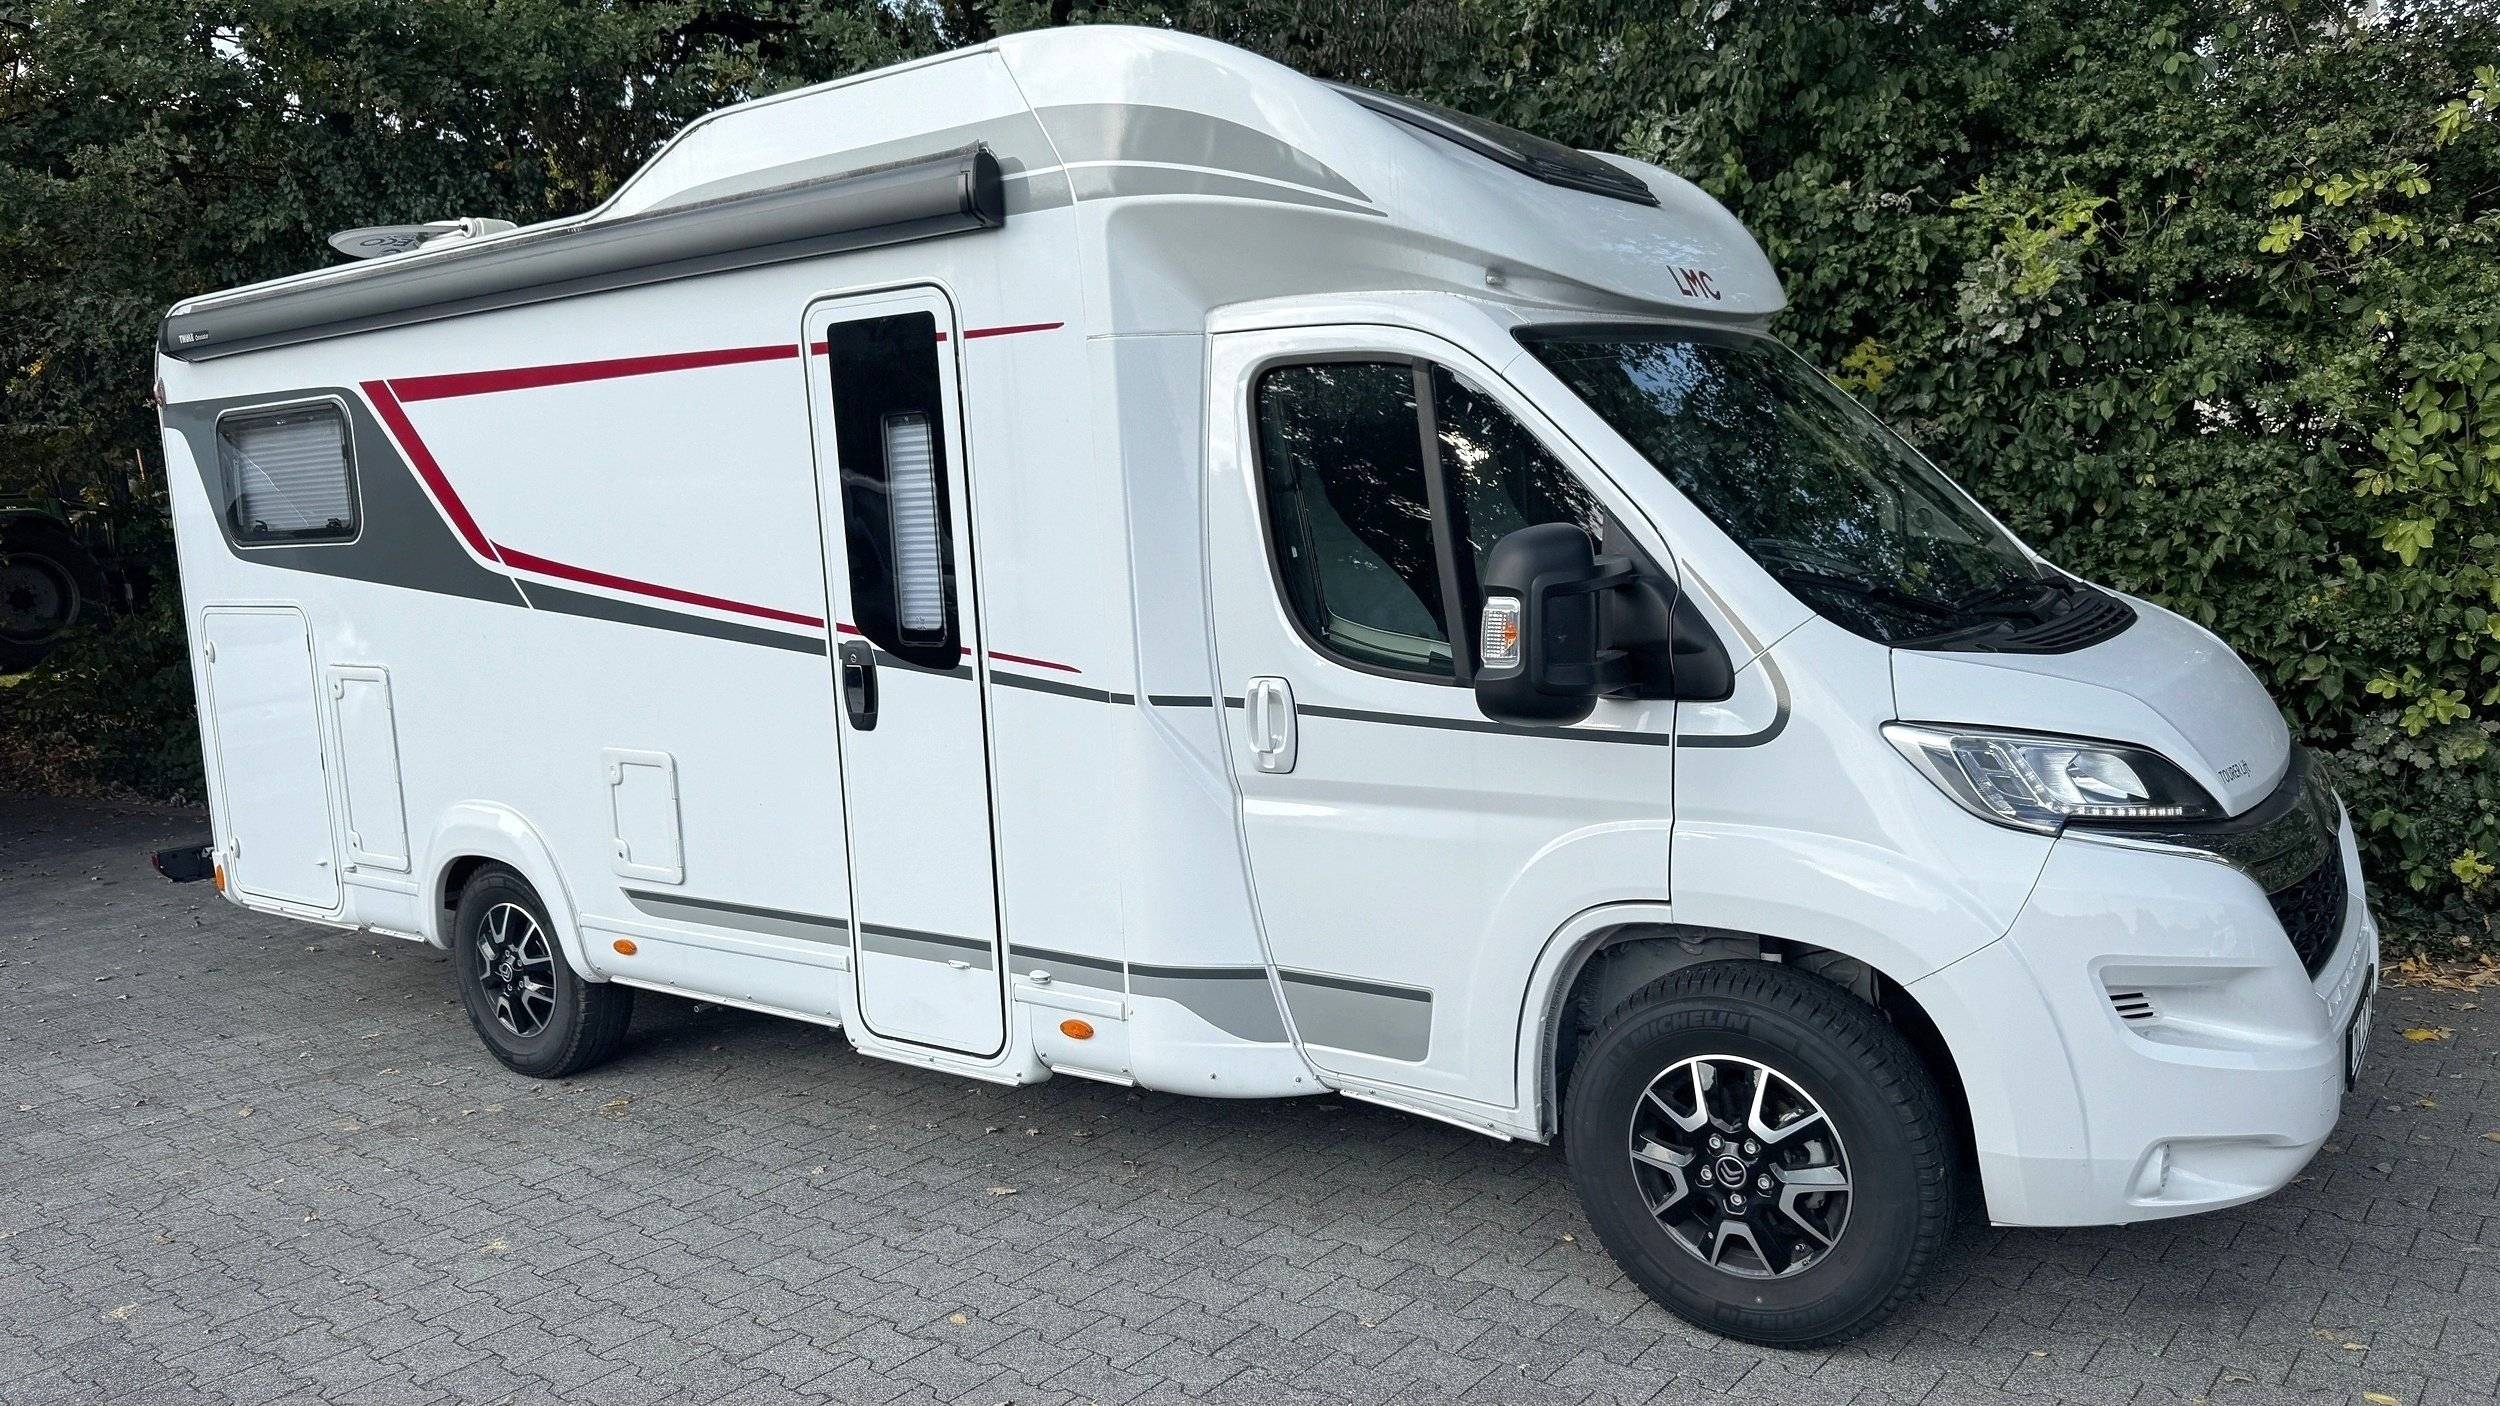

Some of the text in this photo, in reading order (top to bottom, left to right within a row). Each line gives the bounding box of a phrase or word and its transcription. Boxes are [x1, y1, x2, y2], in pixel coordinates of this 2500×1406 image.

[1665, 264, 1722, 301] LMC
[178, 333, 195, 344] THULE
[2217, 762, 2244, 785] TOURER
[1632, 1009, 1750, 1045] MICHELIN
